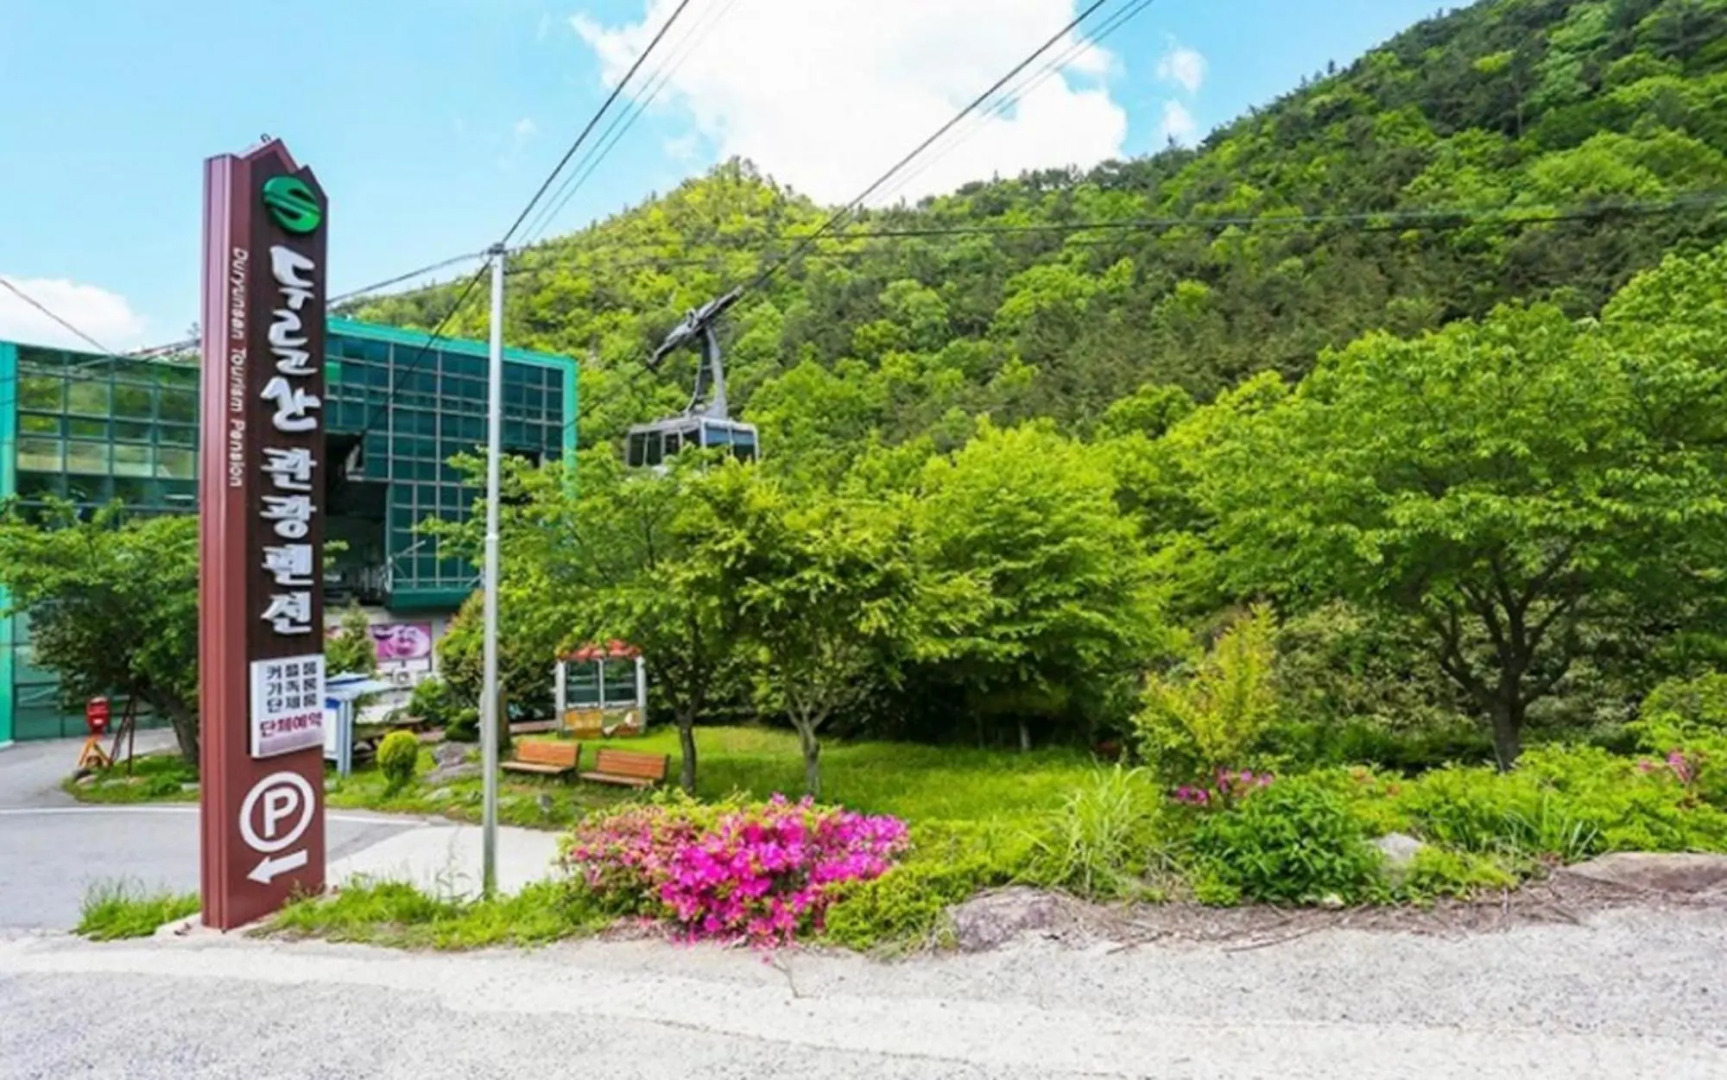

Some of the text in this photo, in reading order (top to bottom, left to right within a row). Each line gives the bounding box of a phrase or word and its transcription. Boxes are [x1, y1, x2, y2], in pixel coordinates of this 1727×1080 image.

[229, 347, 247, 411] Tourism
[229, 419, 246, 487] Pension
[259, 245, 322, 634] 두륜산 관광펜션
[264, 787, 299, 838] P
